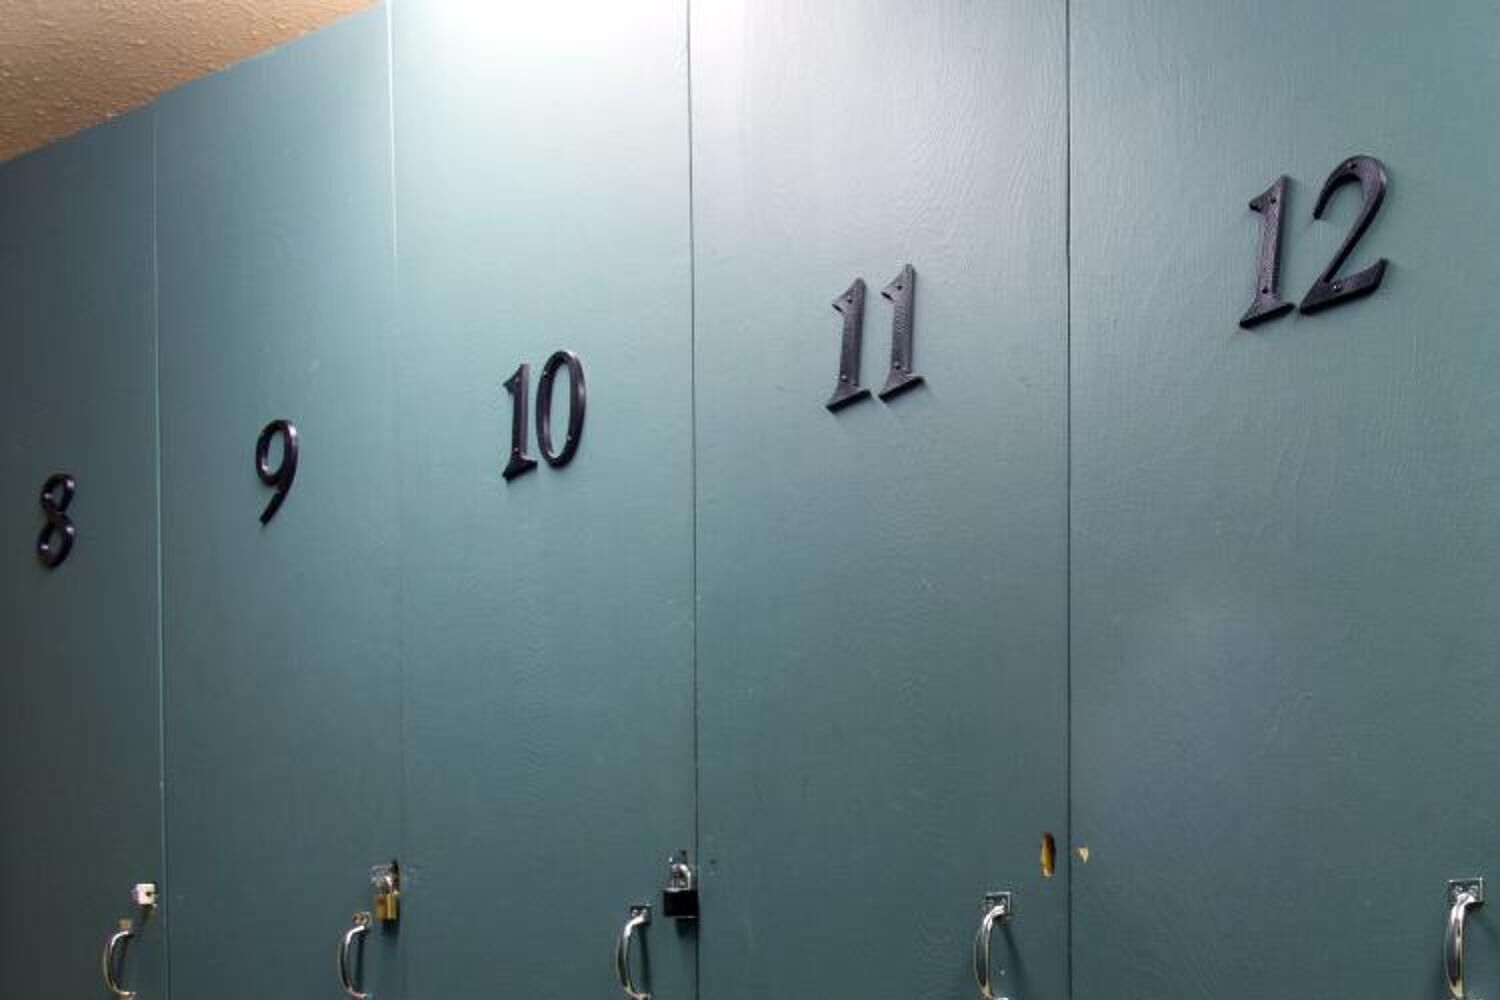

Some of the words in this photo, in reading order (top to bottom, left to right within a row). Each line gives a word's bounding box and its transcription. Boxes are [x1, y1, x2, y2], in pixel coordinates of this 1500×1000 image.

[1239, 155, 1391, 330] 12
[825, 264, 927, 415] 11
[255, 420, 299, 526] 9
[502, 350, 586, 480] 10
[38, 473, 76, 569] 8
